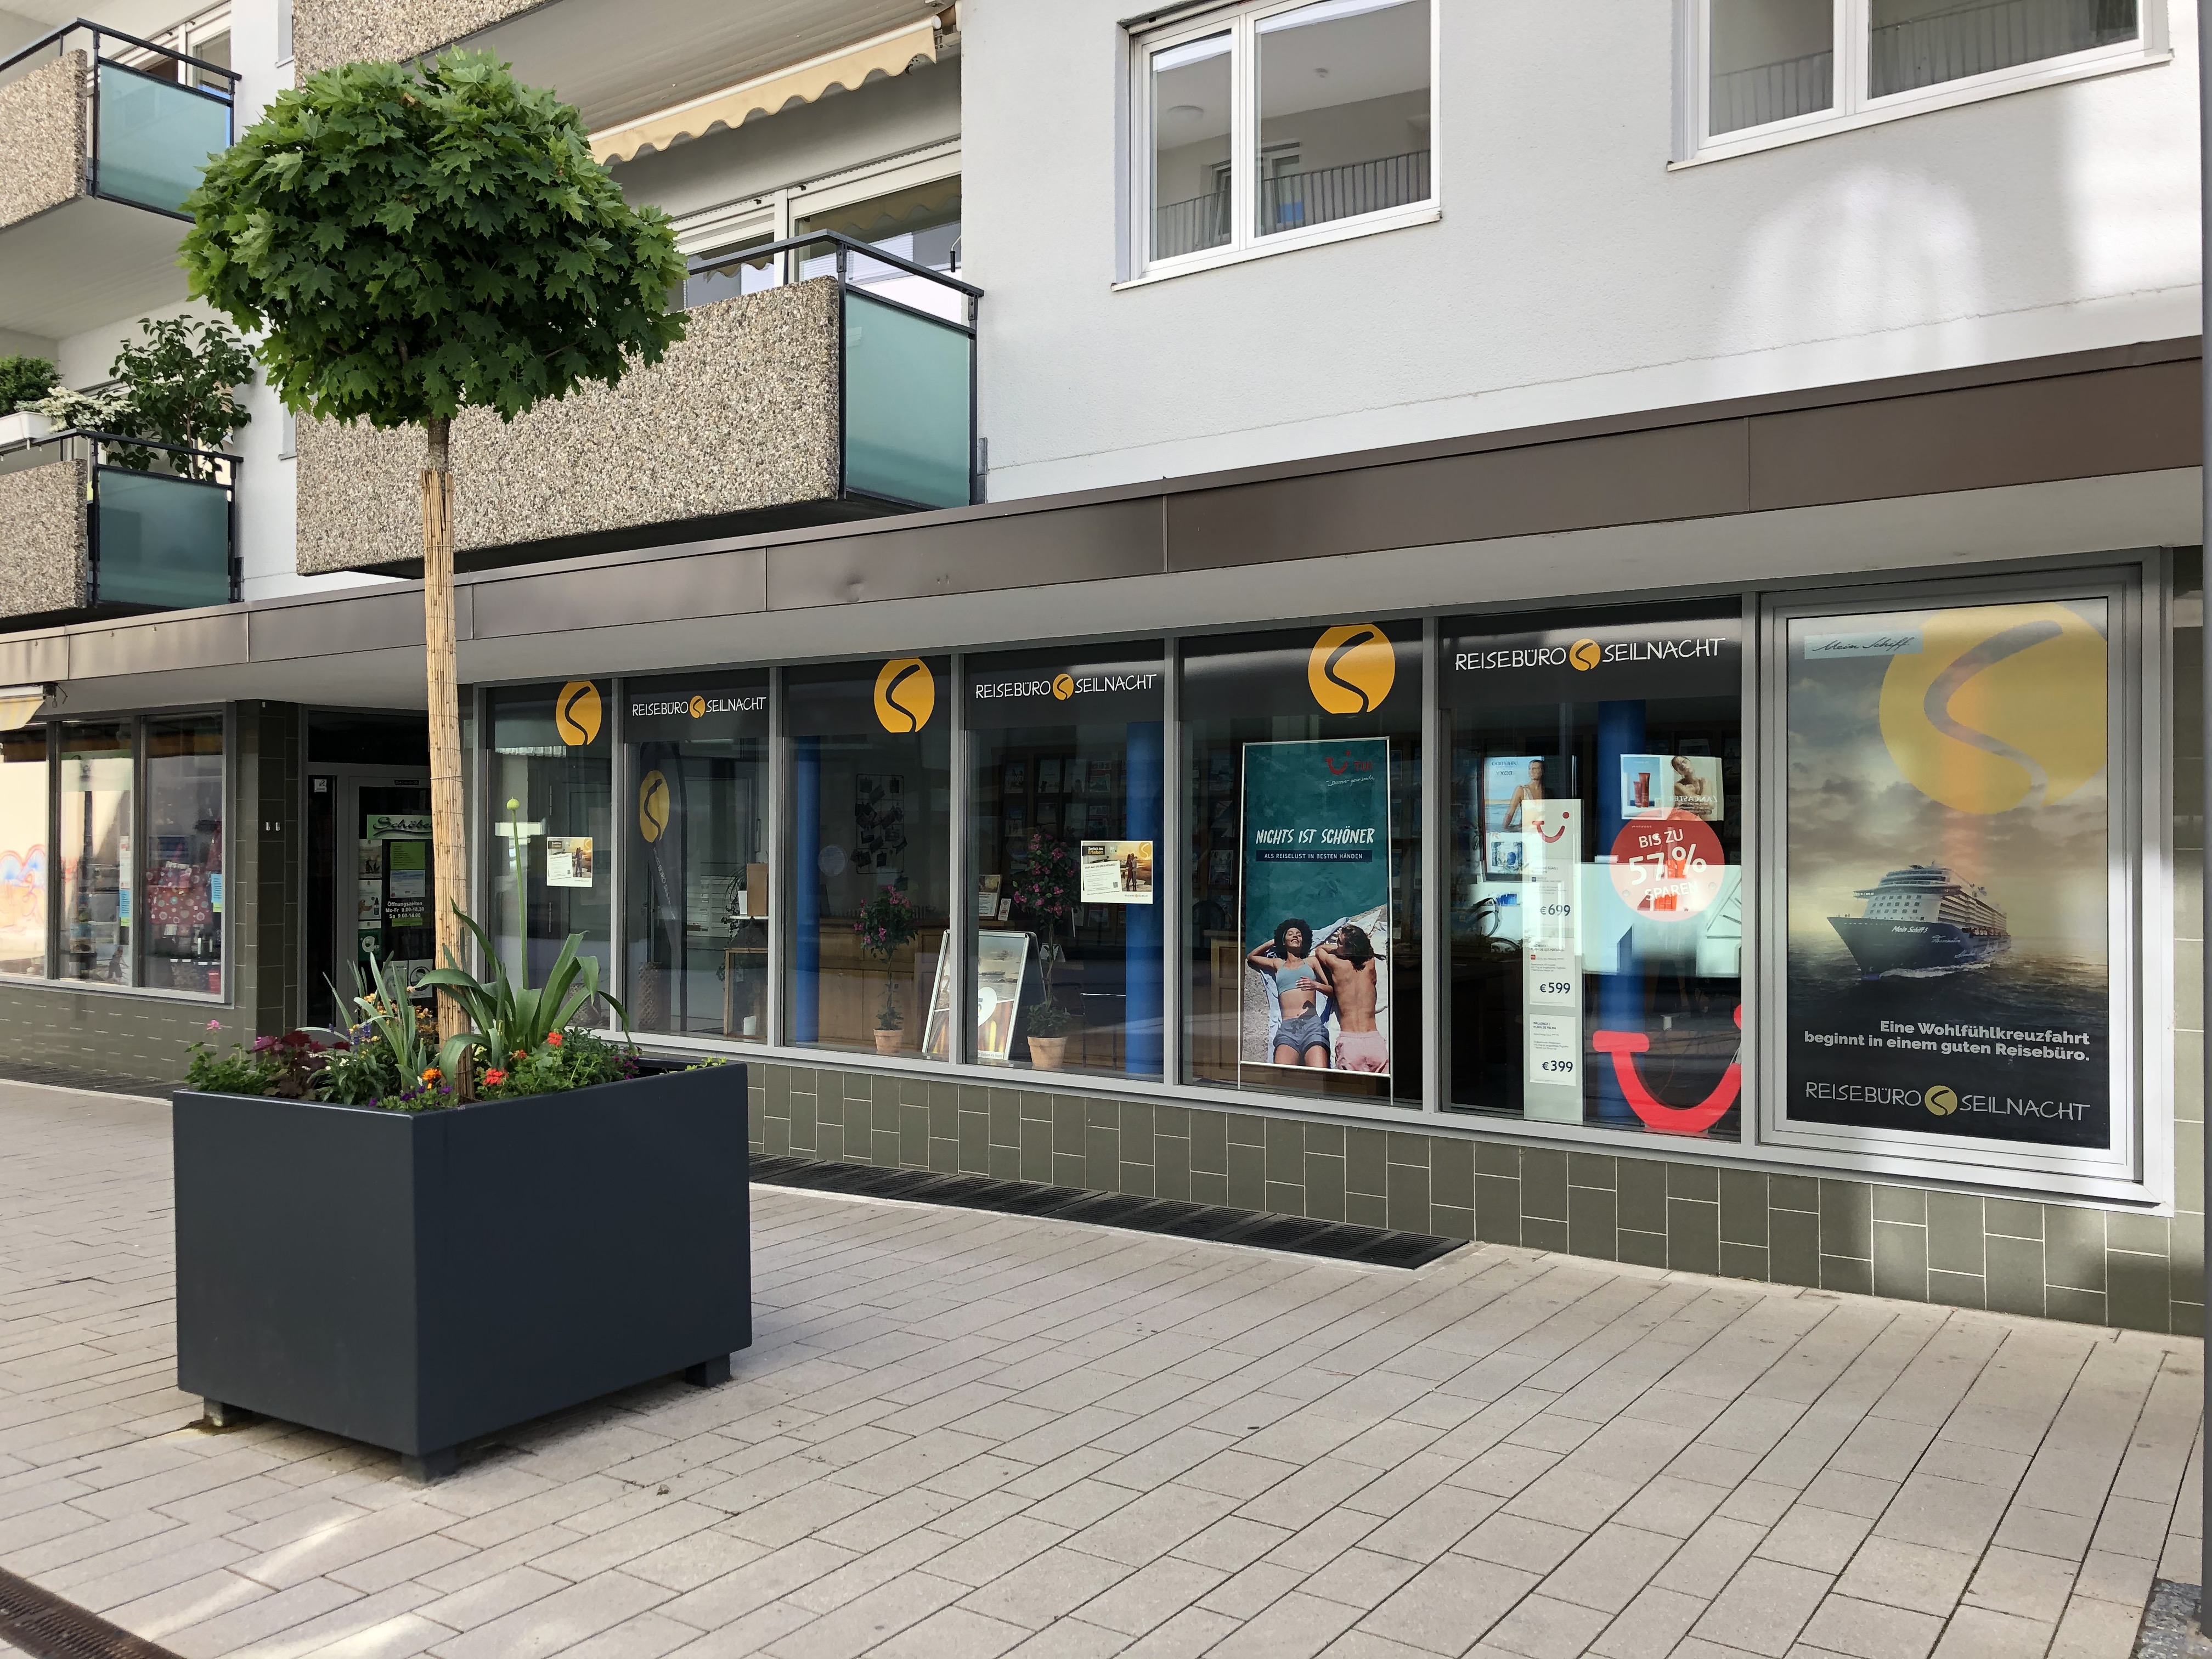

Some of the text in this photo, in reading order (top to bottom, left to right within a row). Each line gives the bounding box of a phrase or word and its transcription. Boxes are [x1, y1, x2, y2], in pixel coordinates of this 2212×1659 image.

[1455, 637, 1726, 671] REISEBÜRO SEILNACHT
[975, 674, 1157, 698] REISEBÜRO SEILNACHT
[632, 697, 767, 716] REISEBÜRO SEILNACHT
[1353, 760, 1373, 772] TUI
[1350, 778, 1361, 787] your
[1255, 825, 1375, 845] NICHTS IST SCHÖNER
[1638, 828, 1684, 849] BIS ZU
[1644, 881, 1699, 901] SPAREN
[1880, 1020, 2090, 1046] Eine Wohlfühlkreuzfahrt
[1804, 1031, 2090, 1061] beginnt in einem guten Reisebüro.
[1805, 1081, 2090, 1121] REISEBÜRO SEILNACHT
